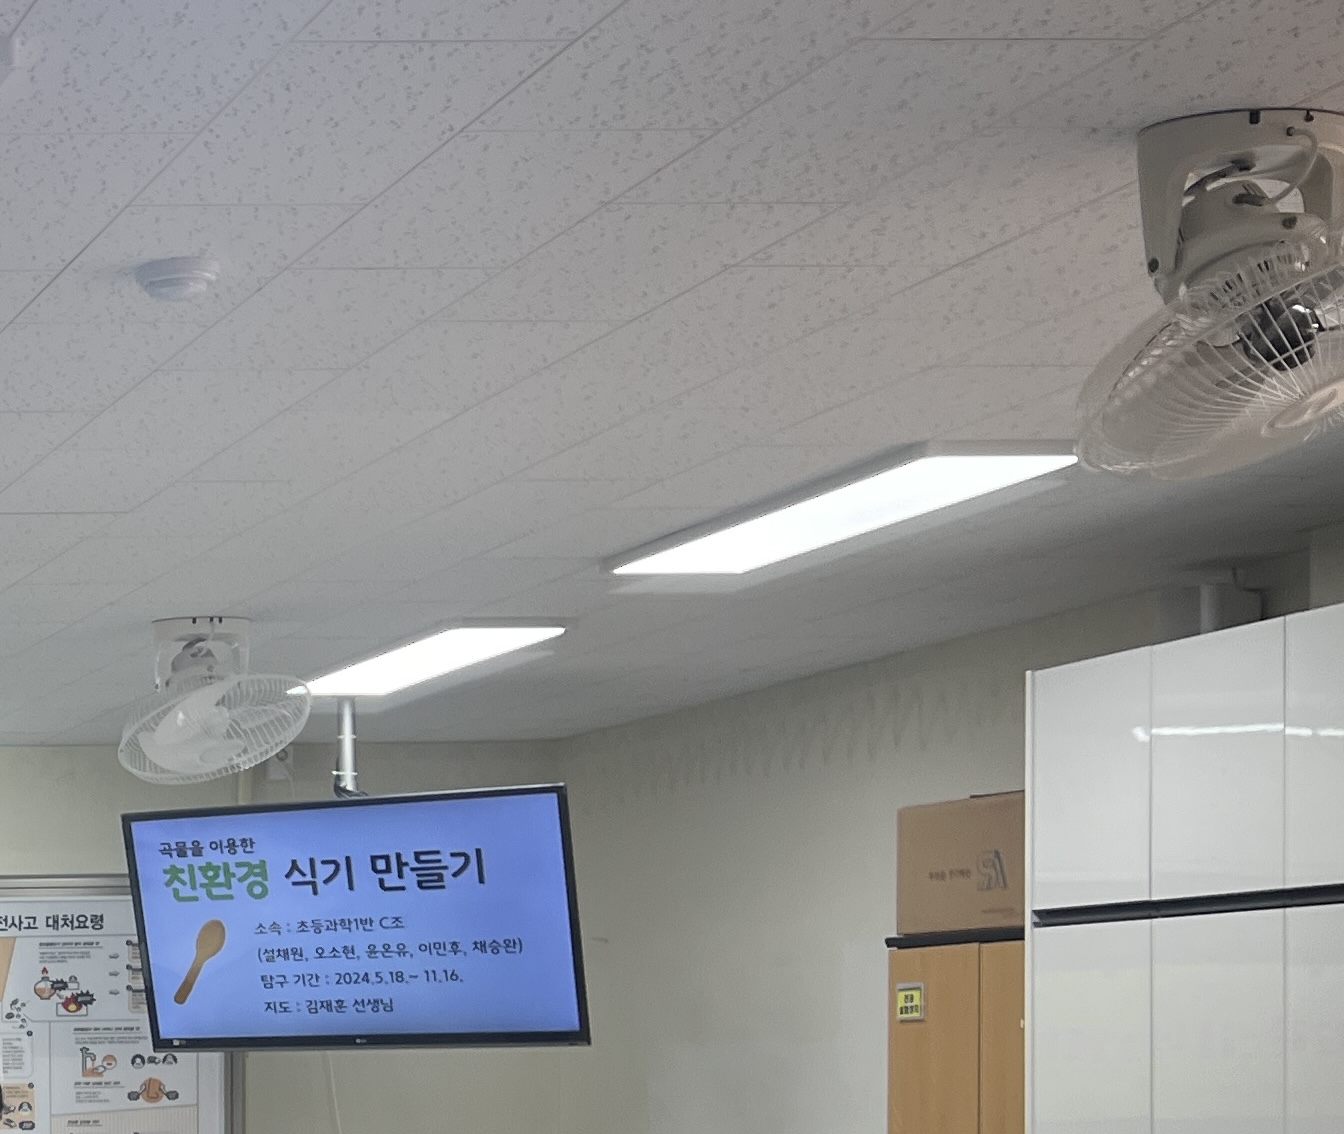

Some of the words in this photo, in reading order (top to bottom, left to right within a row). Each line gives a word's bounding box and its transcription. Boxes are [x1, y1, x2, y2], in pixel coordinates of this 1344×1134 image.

[158, 839, 204, 858] 곡물을
[209, 837, 256, 855] 이용한
[163, 860, 270, 902] 친환경
[284, 855, 354, 896] 식기
[370, 848, 486, 891] 만들기
[45, 913, 104, 931] 대처요령
[254, 919, 282, 935] 소속
[296, 917, 374, 934] 초등과학1반
[379, 916, 405, 930] C조
[261, 973, 289, 989] 탐구
[294, 973, 321, 988] 기간
[424, 969, 464, 983] 11.16.
[264, 999, 293, 1014] 지도
[306, 999, 348, 1014] 김재훈
[352, 997, 394, 1013] 선생님
